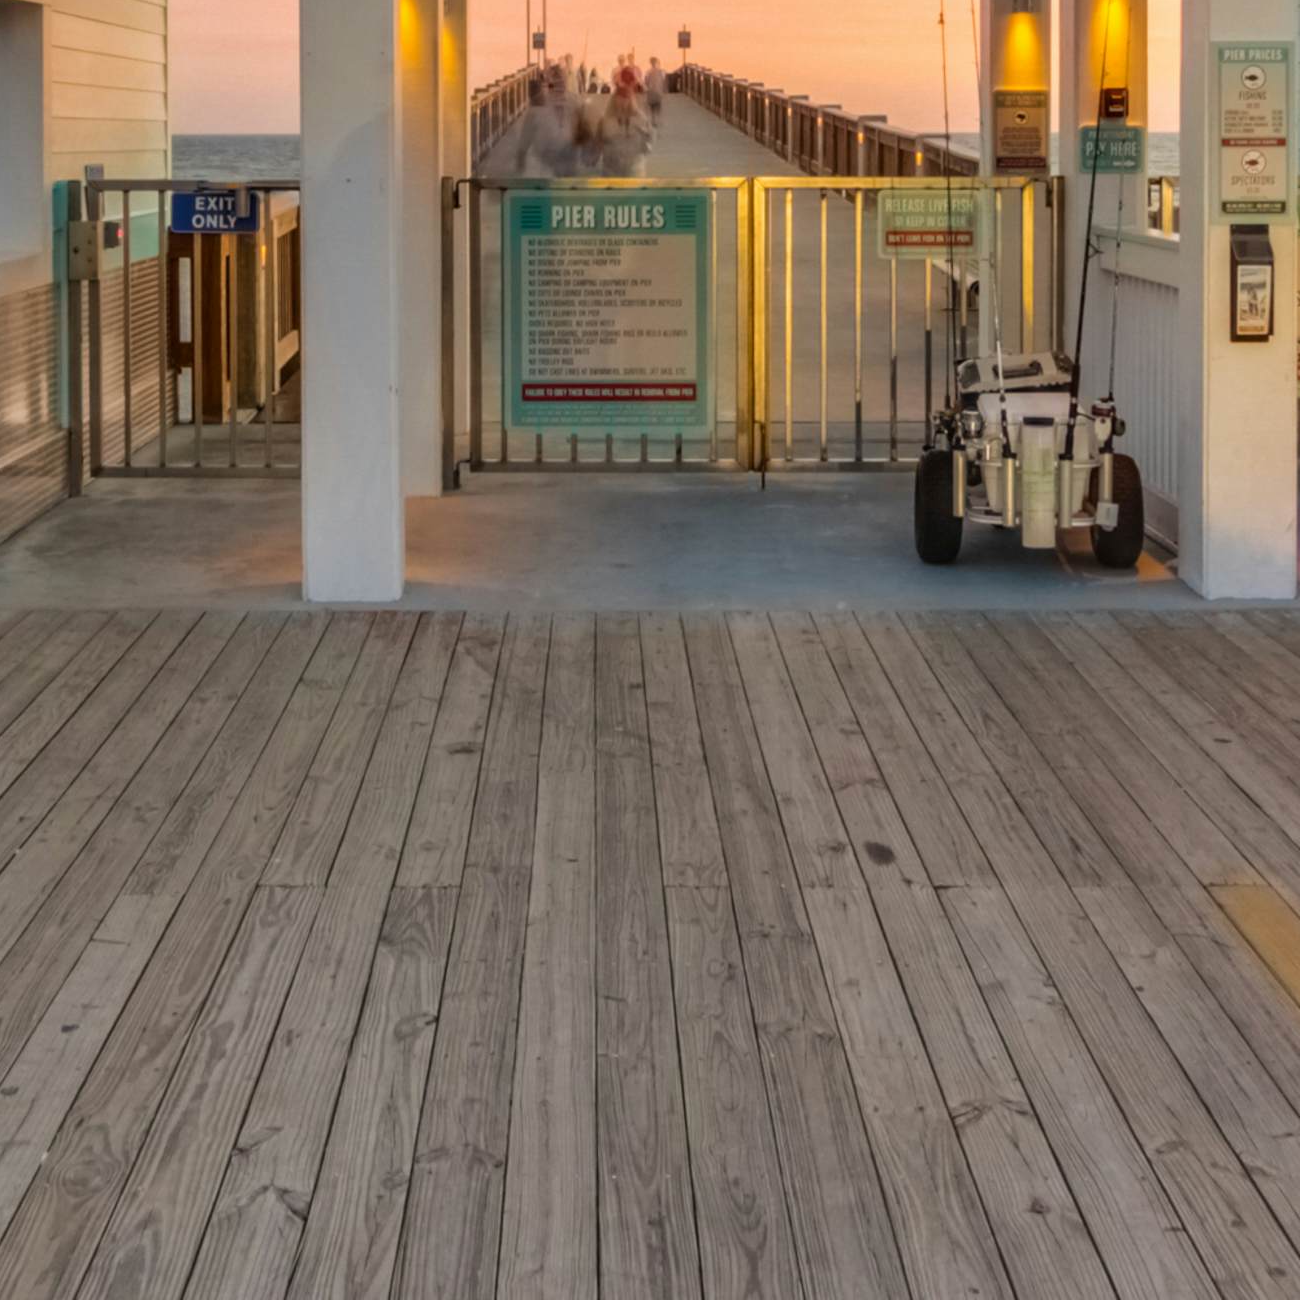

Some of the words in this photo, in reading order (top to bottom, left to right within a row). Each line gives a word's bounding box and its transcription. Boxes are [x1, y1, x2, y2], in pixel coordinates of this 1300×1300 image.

[1224, 49, 1245, 61] PIER
[1249, 49, 1283, 61] PRICES
[1110, 141, 1137, 156] HERE
[195, 197, 235, 211] EXIT
[885, 199, 925, 213] RELEASE
[951, 199, 973, 213] FISH
[192, 214, 237, 229] ONLY
[551, 205, 595, 229] PIER
[603, 205, 665, 229] RULES
